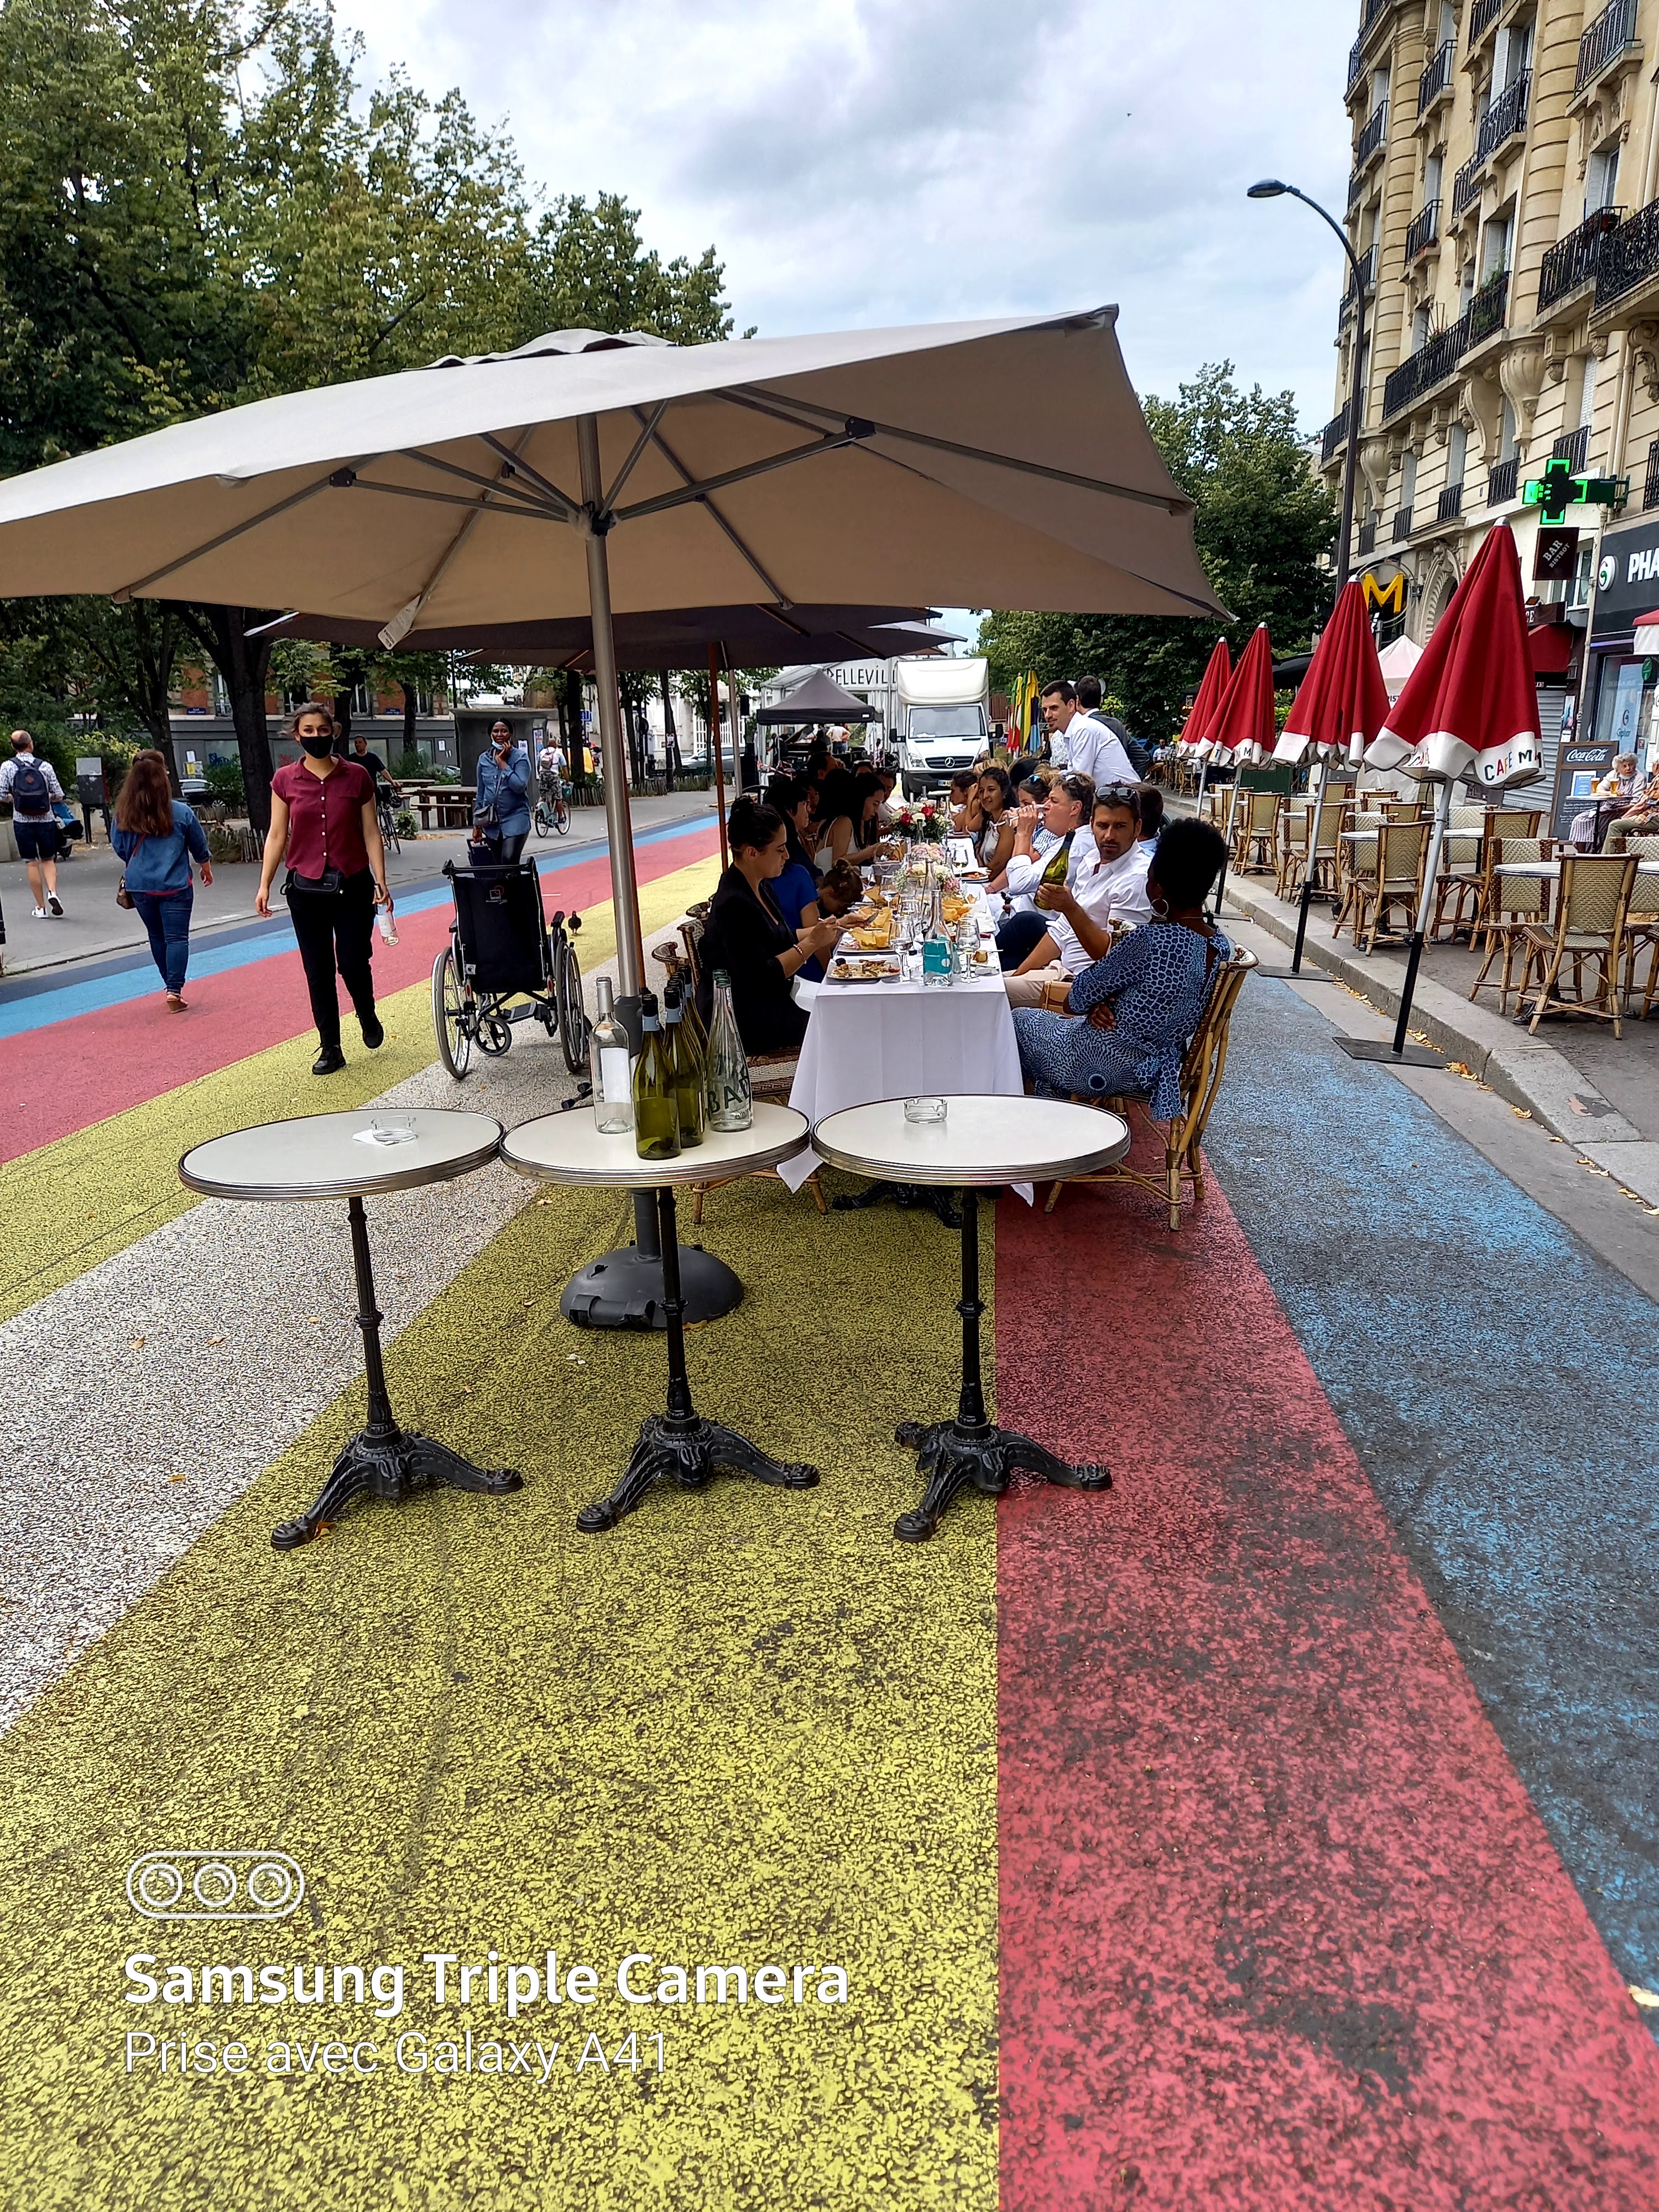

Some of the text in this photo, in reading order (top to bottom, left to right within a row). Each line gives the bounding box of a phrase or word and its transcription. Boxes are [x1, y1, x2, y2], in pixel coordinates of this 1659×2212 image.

[1543, 540, 1563, 561] BAR
[1549, 542, 1570, 568] BISTROT
[1363, 572, 1404, 613] M
[1484, 749, 1512, 781] CAFÉ
[1566, 748, 1609, 762] Coca-Cola
